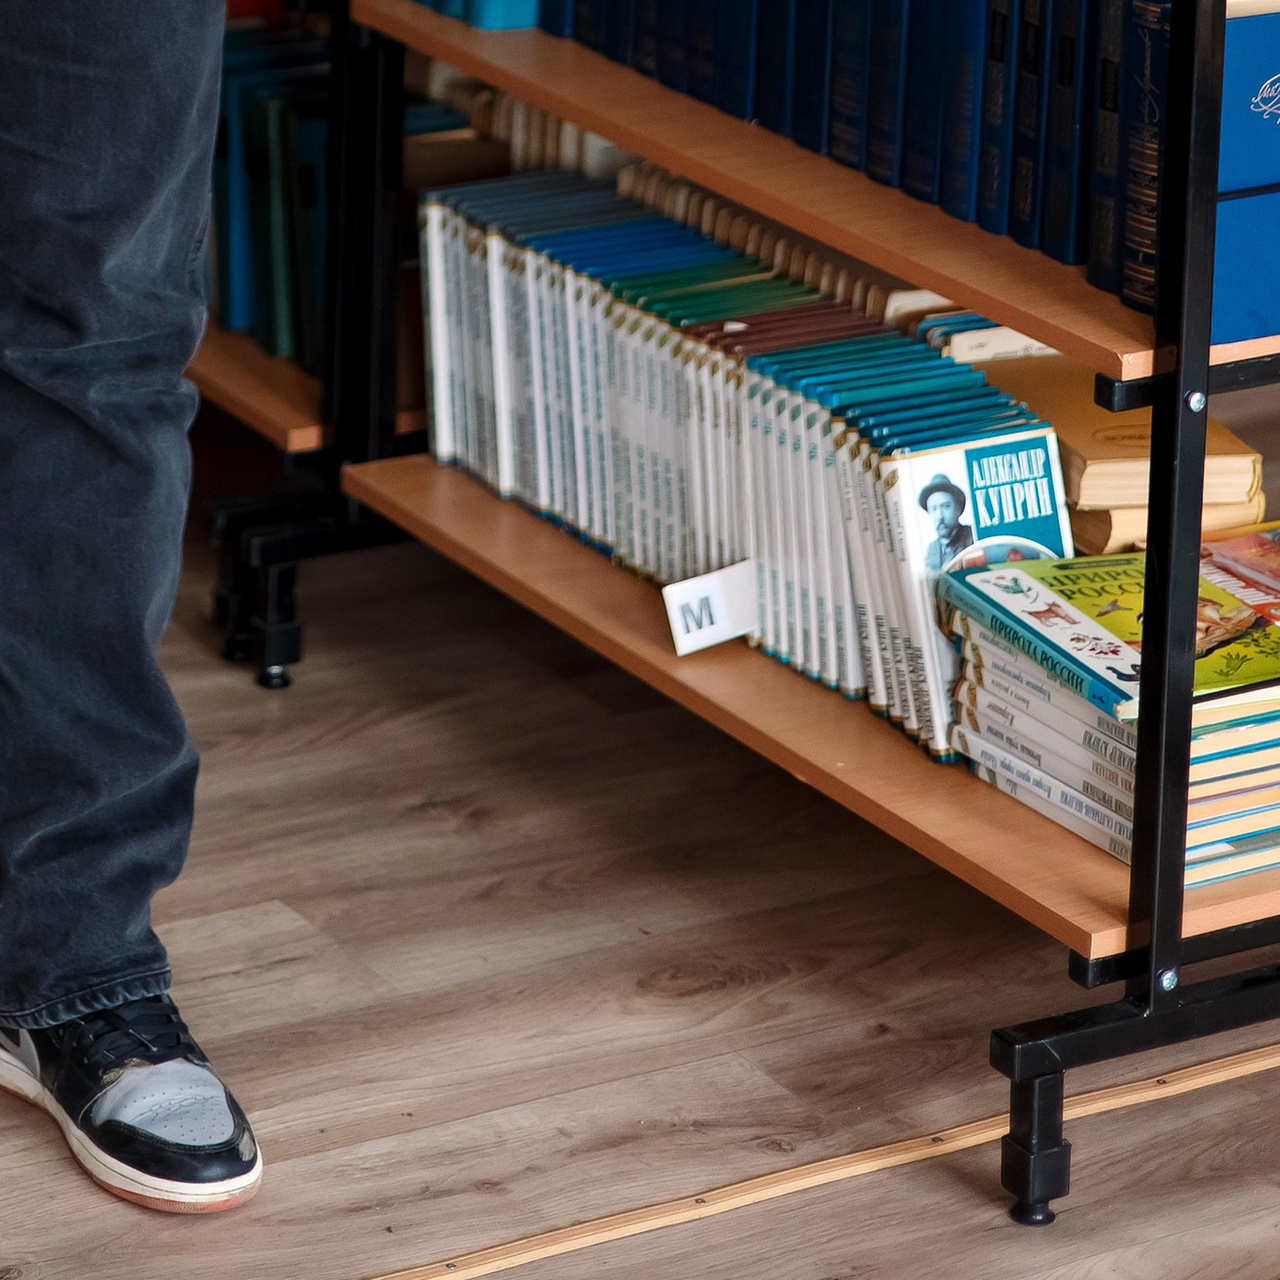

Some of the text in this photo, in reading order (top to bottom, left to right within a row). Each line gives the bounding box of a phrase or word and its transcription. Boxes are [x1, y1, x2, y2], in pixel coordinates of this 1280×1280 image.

[972, 447, 1046, 489] АЛЕКСАНДР
[974, 477, 1054, 528] КУПРИН
[1039, 567, 1144, 589] ПРИРО
[1058, 581, 1144, 601] РОСС
[680, 595, 716, 634] М
[989, 614, 1039, 659] ПРИРОДА
[1040, 650, 1085, 693] РОССИИ
